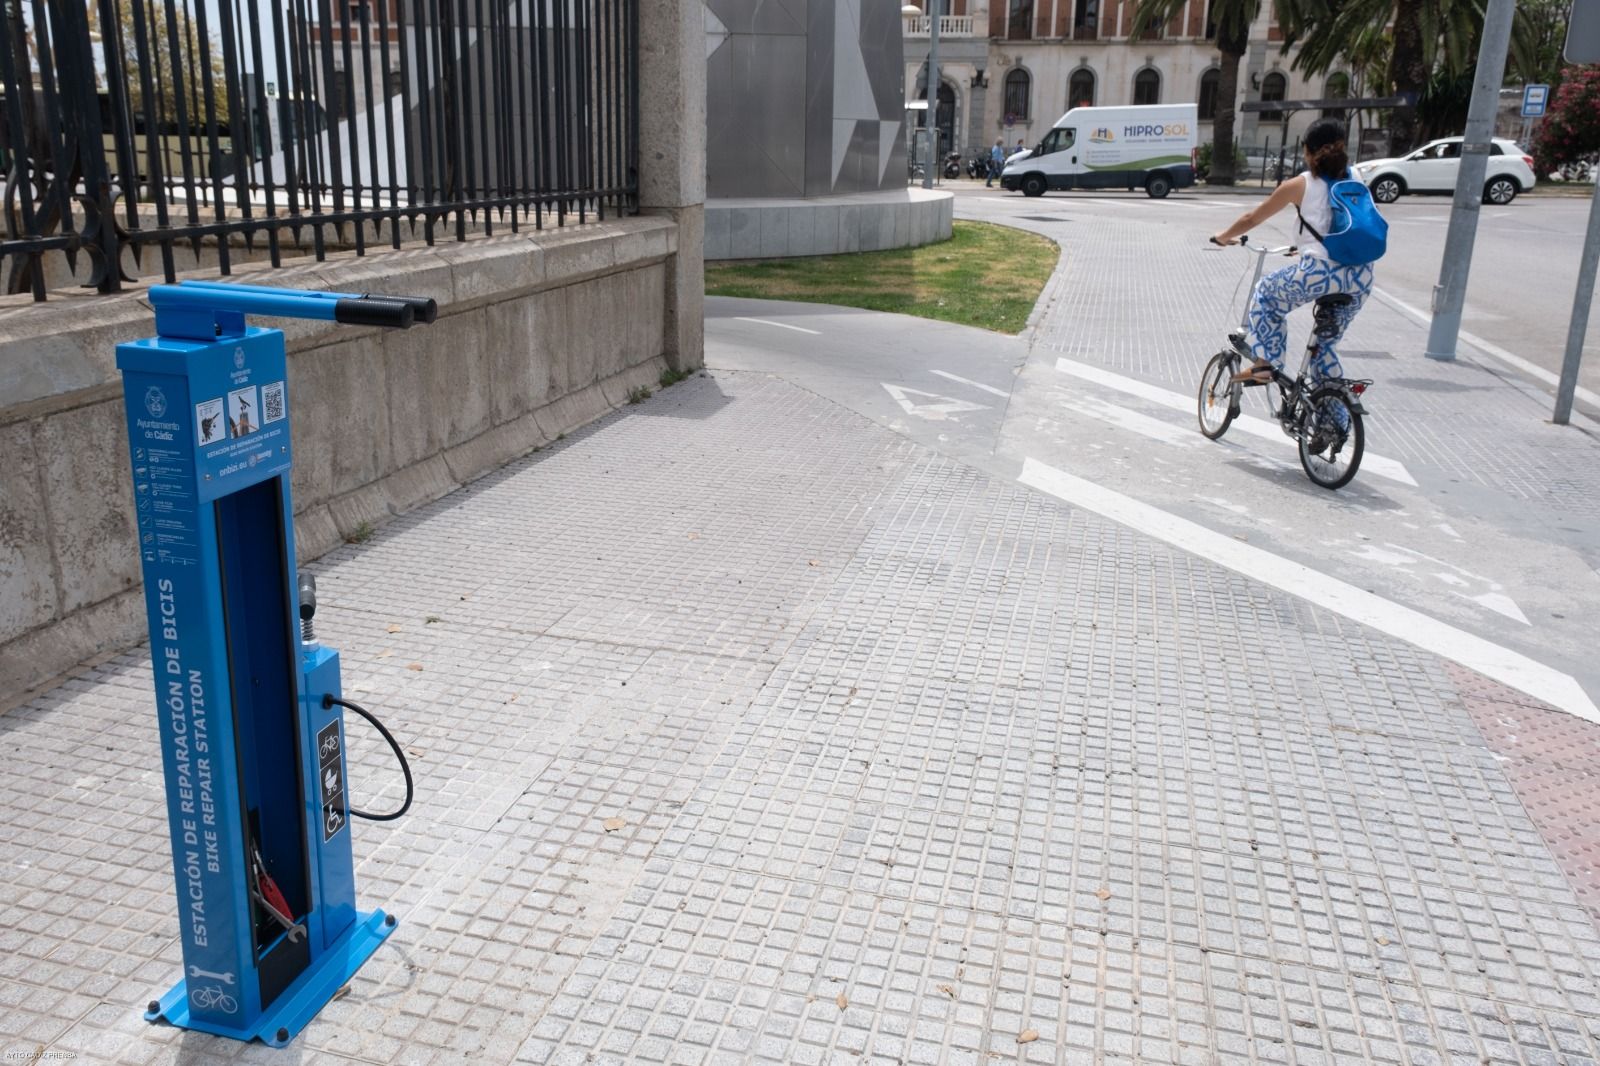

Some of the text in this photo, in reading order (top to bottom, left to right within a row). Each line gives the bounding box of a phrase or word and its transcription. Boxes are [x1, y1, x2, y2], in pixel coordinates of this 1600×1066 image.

[1124, 124, 1190, 137] HIPROSOL
[137, 418, 180, 431] Ayuntamiento
[145, 430, 174, 441] de Cádiz
[158, 578, 177, 641] BICIS
[165, 647, 181, 675] DE
[166, 681, 195, 814] REPARACIÓN
[189, 669, 220, 873] BIKE REPAIR STATION
[183, 819, 198, 846] DE
[183, 851, 208, 947] ESTACIÓN
